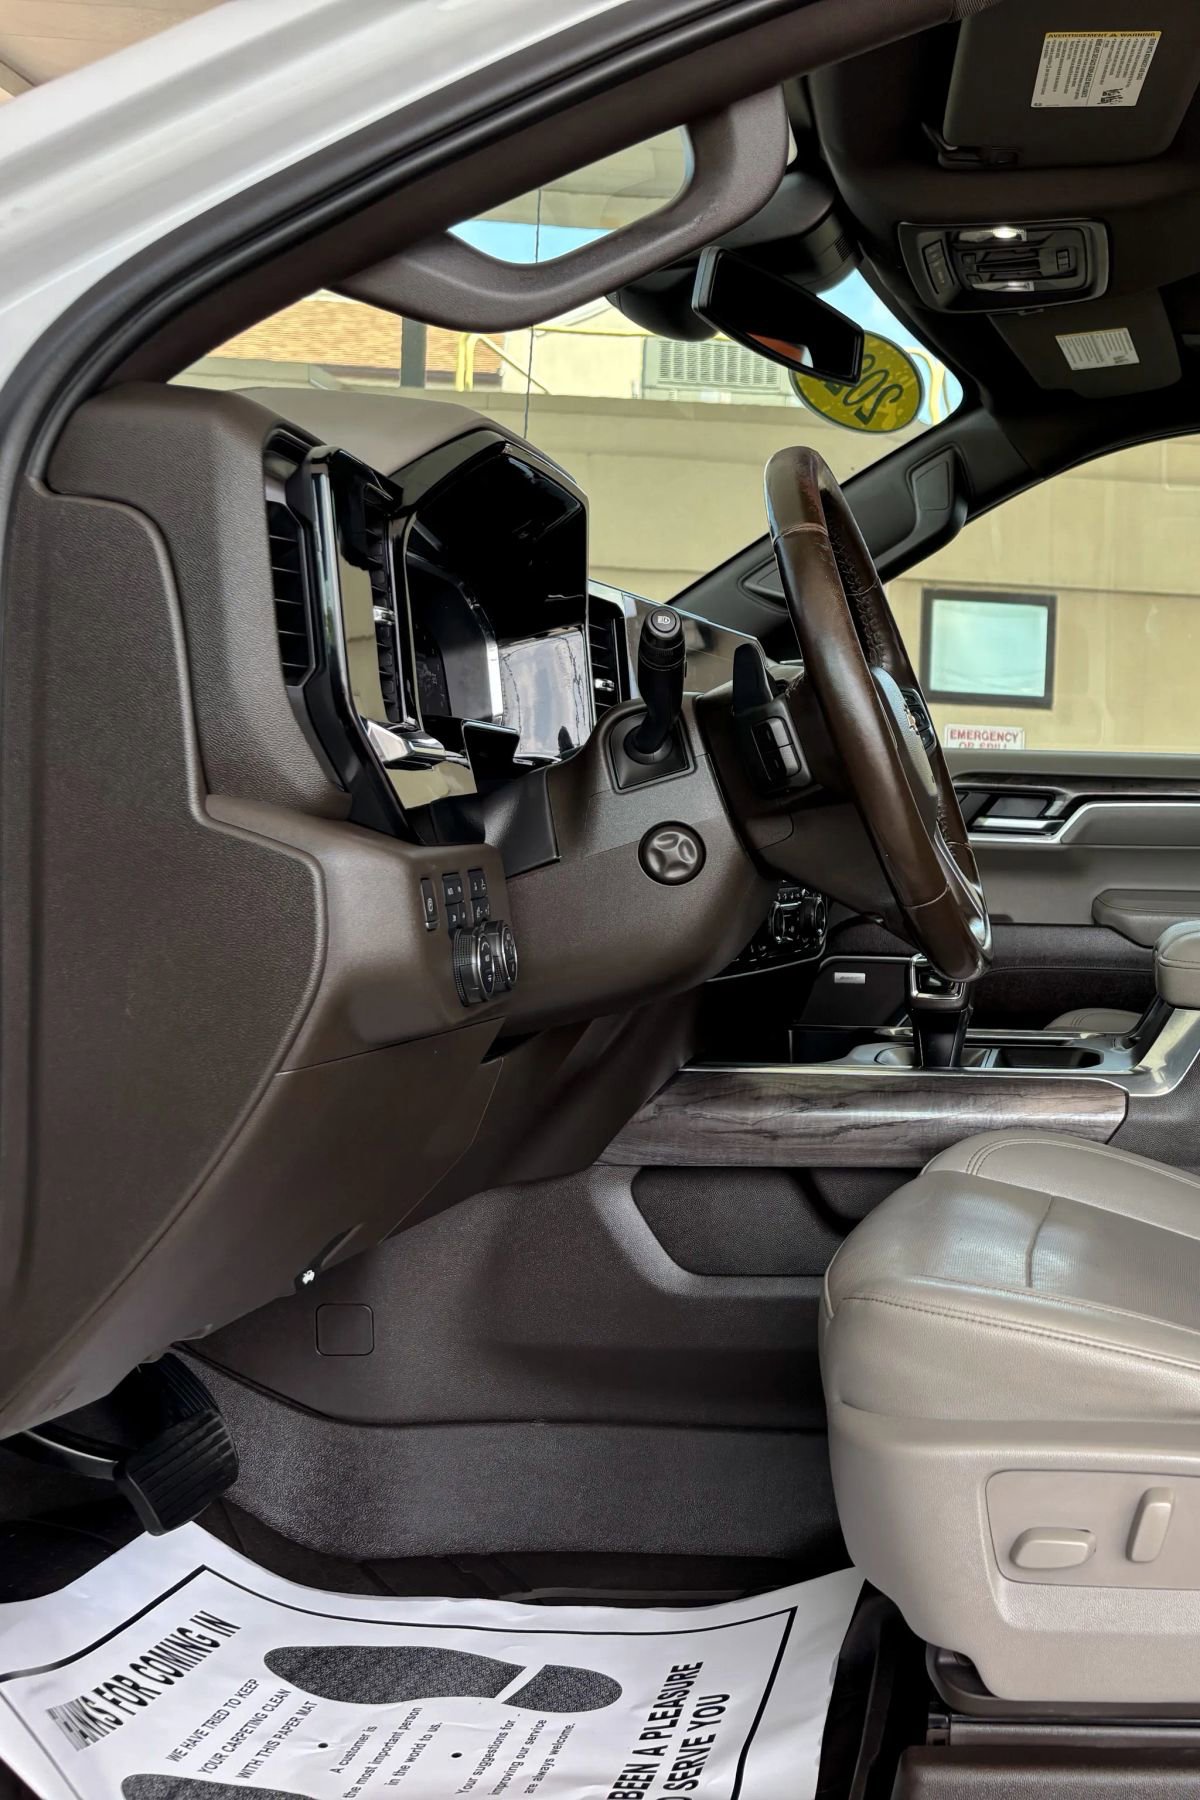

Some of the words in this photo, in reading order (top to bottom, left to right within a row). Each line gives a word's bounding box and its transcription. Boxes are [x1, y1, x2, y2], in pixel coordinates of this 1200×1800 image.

[950, 729, 1019, 743] EMERGENCY
[92, 1674, 162, 1715] FOR
[129, 1627, 221, 1685] COMING
[189, 1610, 242, 1637] IN
[166, 1749, 188, 1762] WE
[180, 1729, 209, 1750] HAVE
[201, 1709, 230, 1731] TRIED
[223, 1698, 241, 1709] TO
[235, 1679, 260, 1699] KEEP
[427, 1722, 443, 1733] us.
[638, 1661, 704, 1740] PLEASURE
[687, 1694, 730, 1732] YOU
[198, 1752, 229, 1774] YOUR
[222, 1713, 268, 1752] CARPETING
[262, 1688, 292, 1713] CLEAN
[235, 1759, 264, 1779] WITH
[255, 1740, 281, 1758] THIS
[273, 1716, 304, 1740] PAPER
[296, 1700, 318, 1717] MAT
[338, 1733, 371, 1766] customer
[342, 1786, 362, 1798] the
[355, 1766, 378, 1784] most
[368, 1731, 405, 1764] important
[399, 1707, 423, 1730] person
[405, 1742, 427, 1763] world
[454, 1777, 478, 1794] Your
[473, 1732, 508, 1776] suggestions
[500, 1720, 516, 1730] for
[488, 1761, 524, 1795] improving
[516, 1747, 530, 1759] our
[525, 1719, 547, 1745] service
[524, 1784, 538, 1794] are
[533, 1758, 555, 1782] always
[549, 1723, 576, 1756] welcome.
[632, 1745, 668, 1756] A
[384, 1778, 401, 1786] in
[392, 1765, 411, 1777] the
[607, 1763, 660, 1800] BEEN
[663, 1733, 716, 1791] SERVE
